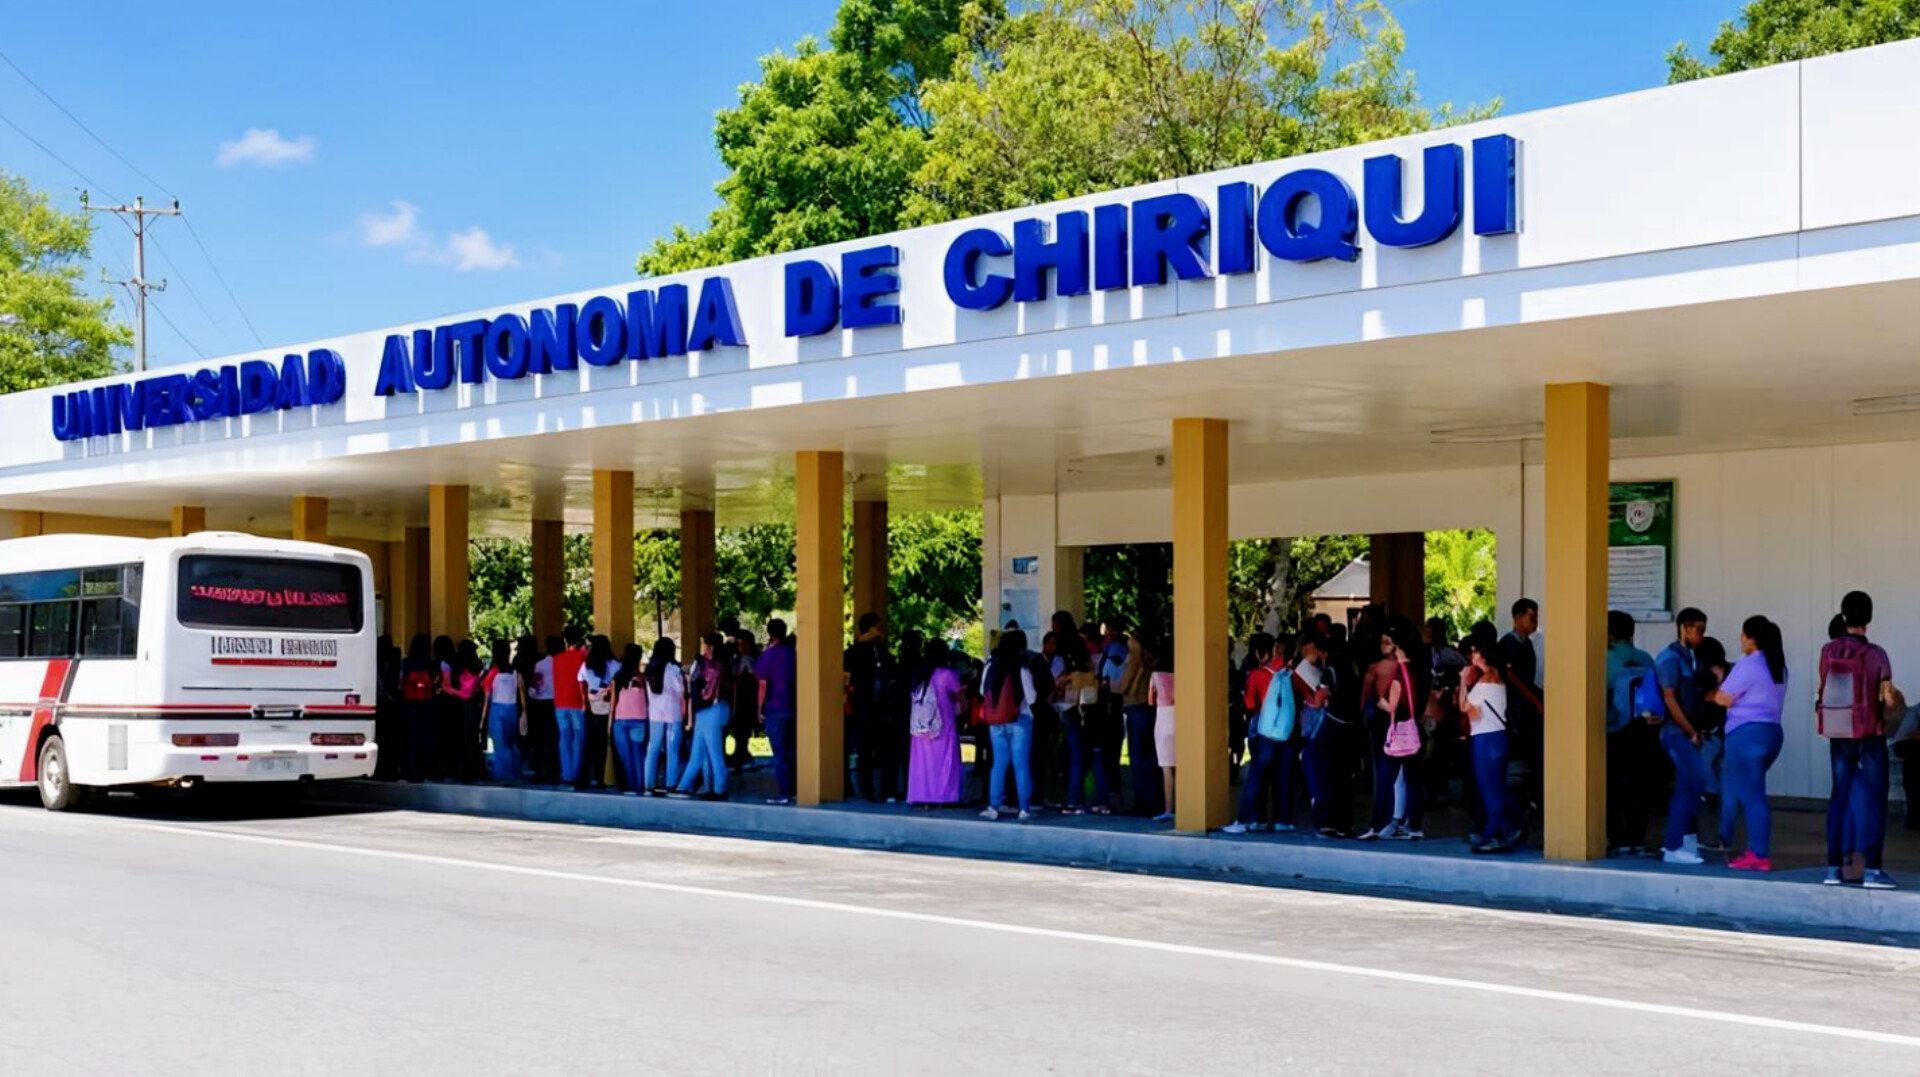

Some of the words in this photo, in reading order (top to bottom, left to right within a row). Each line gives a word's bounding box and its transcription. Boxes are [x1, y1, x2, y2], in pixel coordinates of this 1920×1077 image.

[52, 349, 346, 441] UNIVERSIDAD
[374, 276, 749, 397] AUTONOMA
[784, 245, 902, 338] DE
[944, 134, 1520, 311] CHIRIQUI
